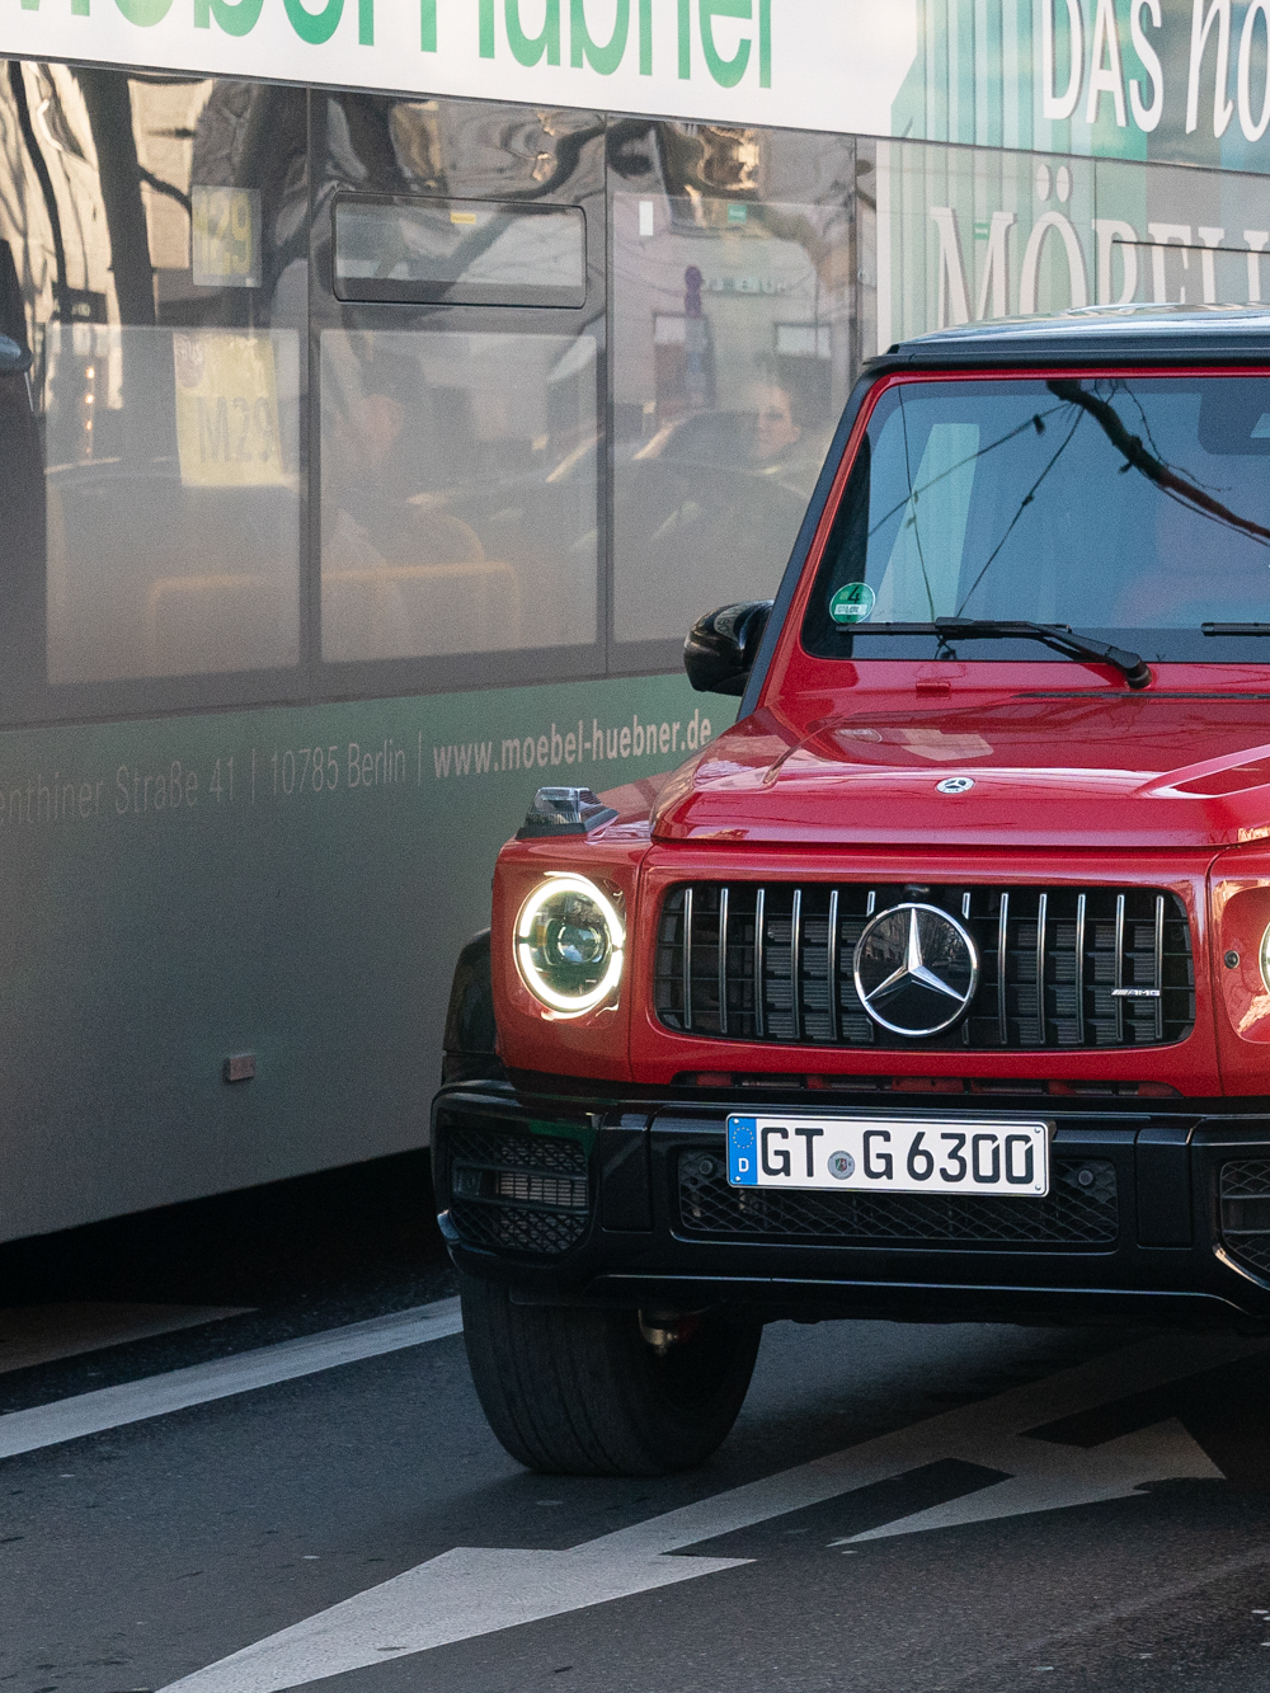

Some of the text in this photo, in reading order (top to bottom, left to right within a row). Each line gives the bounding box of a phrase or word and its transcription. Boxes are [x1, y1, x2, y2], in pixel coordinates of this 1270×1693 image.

[1042, 0, 1164, 133] DAS
[847, 586, 861, 604] 4
[115, 760, 199, 815] Straße
[209, 756, 235, 802] 41
[271, 746, 339, 796] 10785
[346, 739, 406, 788] Berlin
[433, 709, 712, 778] www.moebel-huebner.de
[738, 1158, 749, 1173] D
[760, 1127, 1034, 1185] GT G 6300
